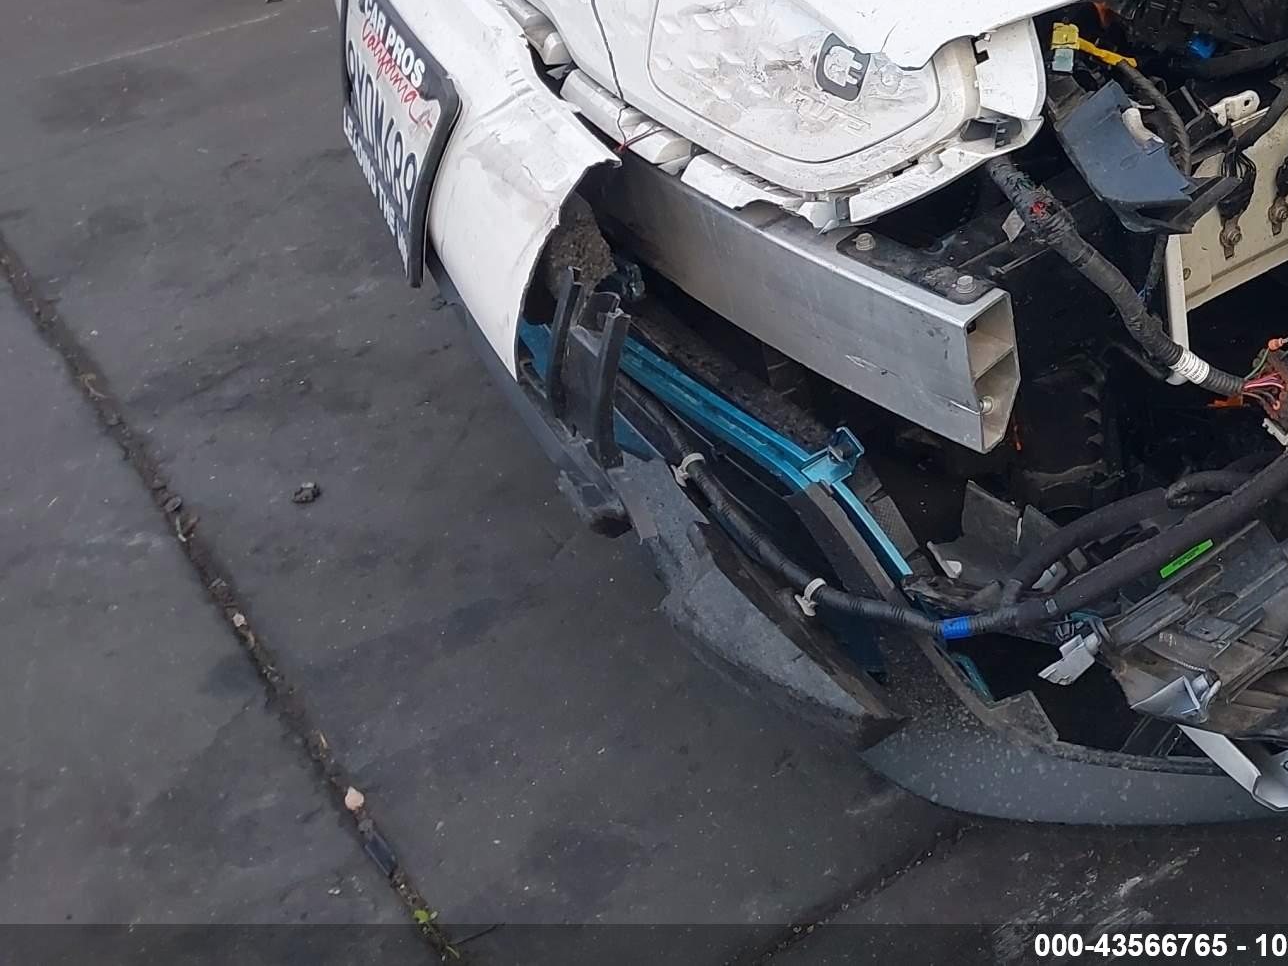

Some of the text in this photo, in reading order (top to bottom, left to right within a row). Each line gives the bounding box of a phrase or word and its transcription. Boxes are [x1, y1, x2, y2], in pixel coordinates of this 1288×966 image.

[362, 19, 418, 124] California
[385, 25, 425, 88] PROS
[343, 107, 377, 198] LEADING
[378, 179, 396, 236] THE
